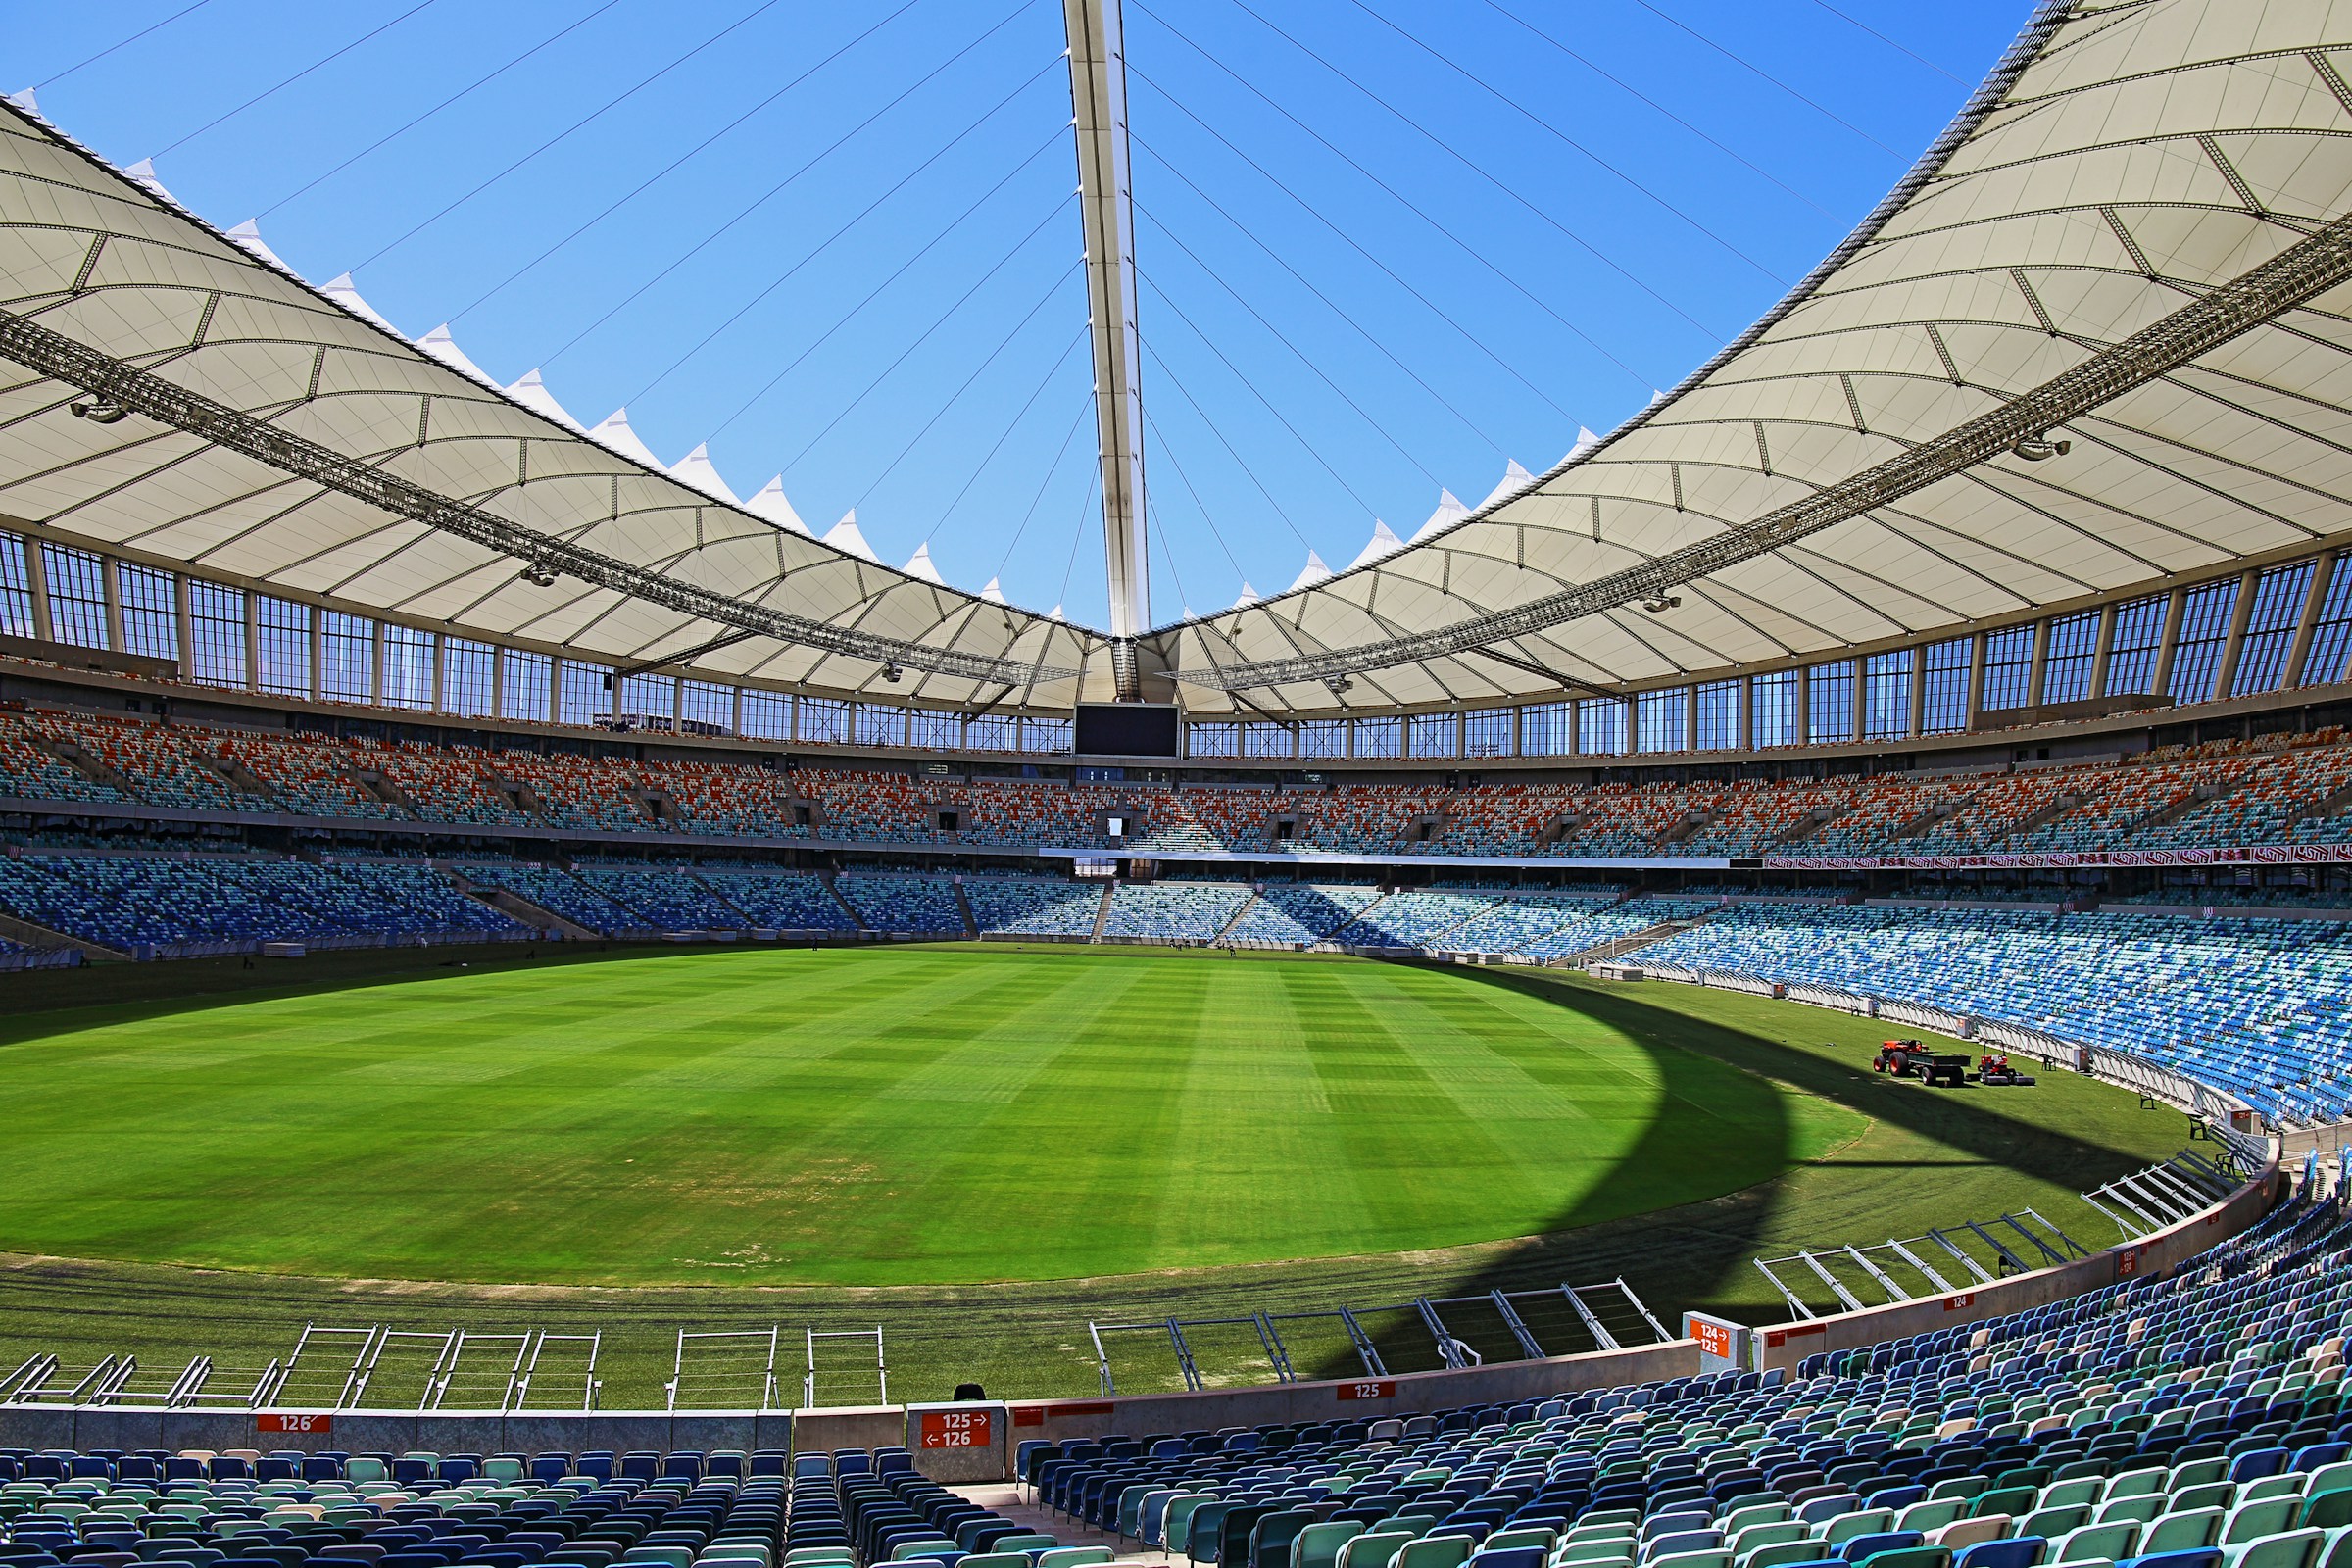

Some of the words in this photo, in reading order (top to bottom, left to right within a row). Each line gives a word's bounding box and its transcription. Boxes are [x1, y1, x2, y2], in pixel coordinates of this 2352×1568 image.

[1953, 1296, 1967, 1308] 124
[1701, 1324, 1718, 1340] 124
[1700, 1338, 1718, 1353] 125
[1354, 1384, 1380, 1397] 125
[280, 1415, 312, 1431] 126
[943, 1413, 971, 1429] 125
[943, 1430, 971, 1446] 126
